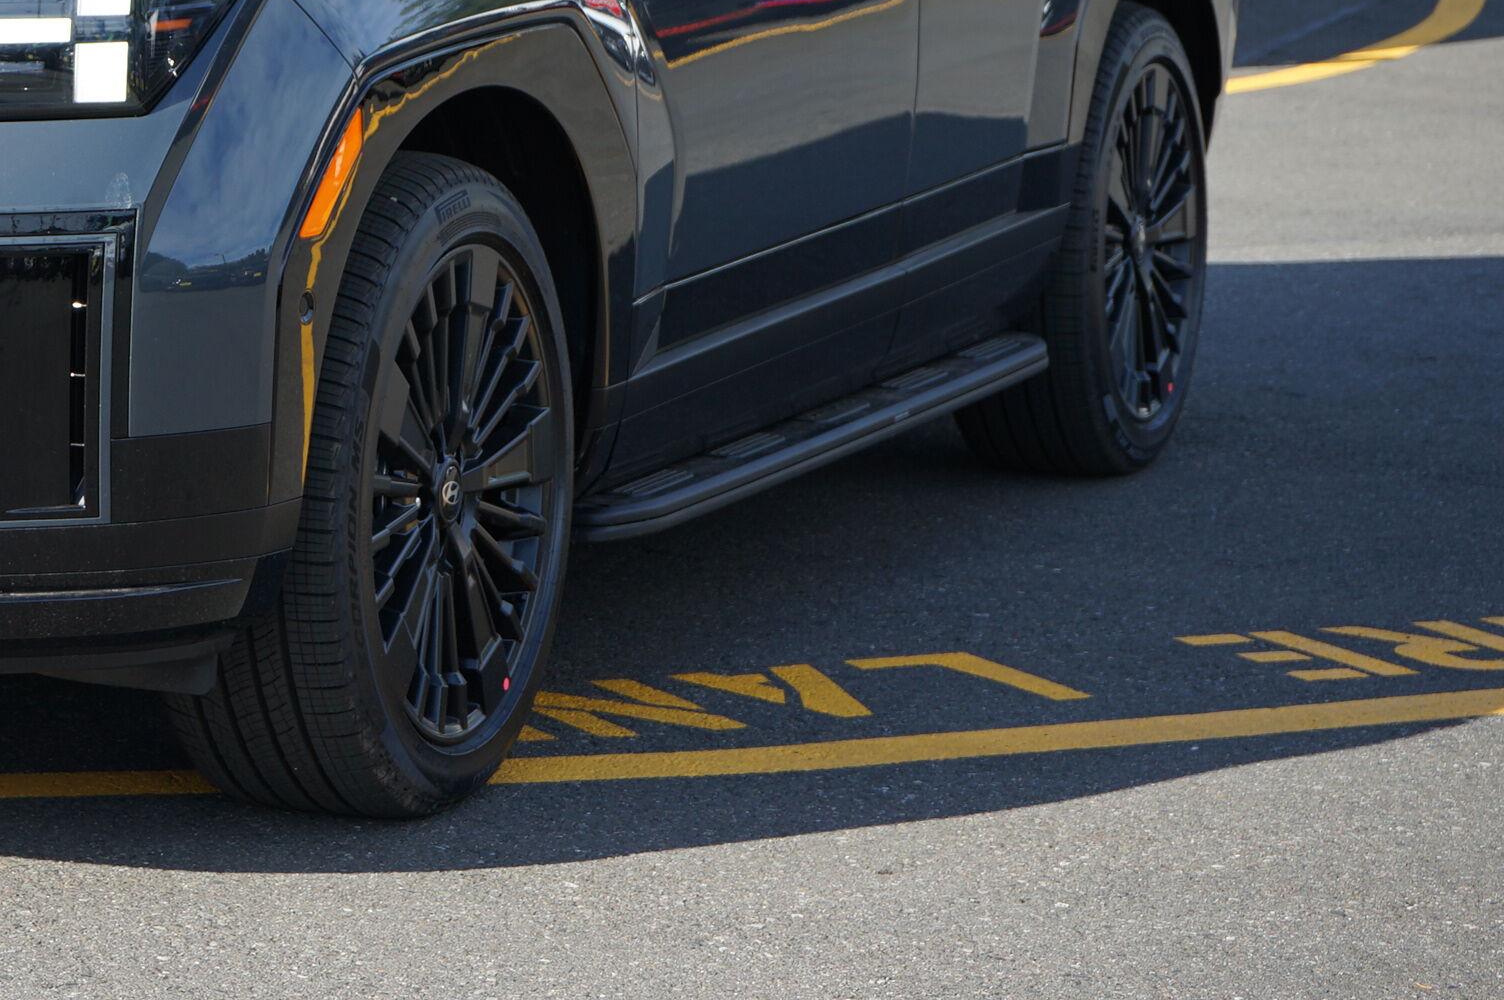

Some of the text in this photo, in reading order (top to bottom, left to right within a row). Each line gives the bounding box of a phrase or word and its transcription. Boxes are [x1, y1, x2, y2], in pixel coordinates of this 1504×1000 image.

[434, 189, 472, 226] PIRELLI
[1173, 616, 1504, 681] RE
[518, 652, 1092, 741] LAN
